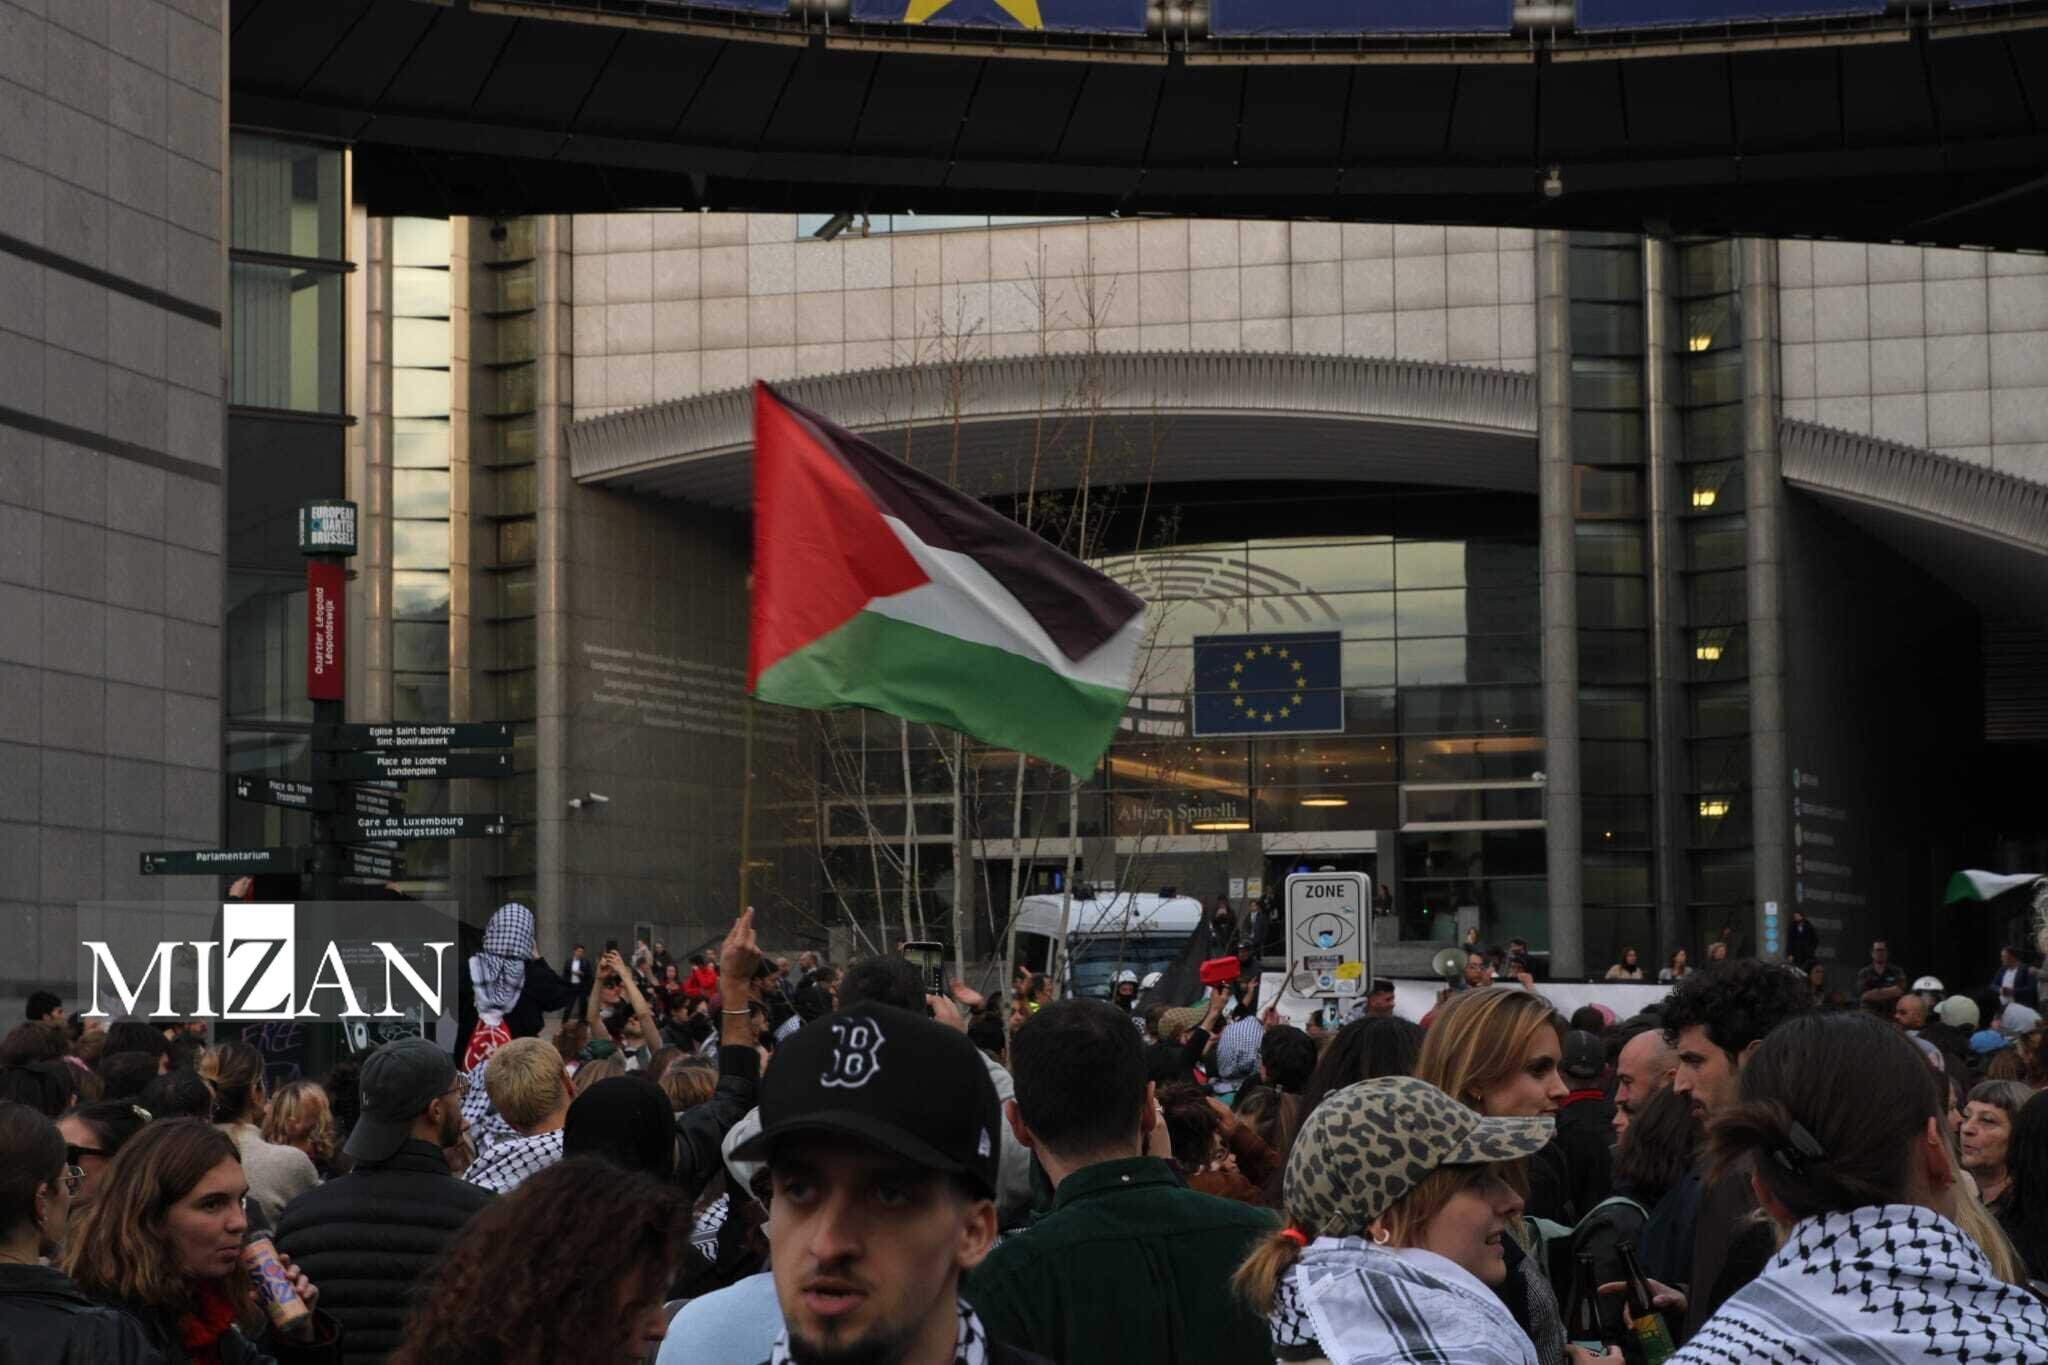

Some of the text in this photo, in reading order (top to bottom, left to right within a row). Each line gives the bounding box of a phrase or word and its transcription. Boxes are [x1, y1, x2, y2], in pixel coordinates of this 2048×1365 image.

[311, 506, 355, 520] EUROPEAN
[311, 519, 355, 532] QUARTER
[311, 531, 355, 546] BRUSSELS
[315, 587, 324, 674] Quartier Léopold
[377, 757, 447, 766] Place de Londres
[387, 767, 437, 777] Londenplein
[358, 816, 464, 828] Gare du Luxembourg
[366, 827, 456, 838] Luxemburgstation
[196, 851, 270, 862] Parlamentarium
[1305, 884, 1345, 898] ZONE
